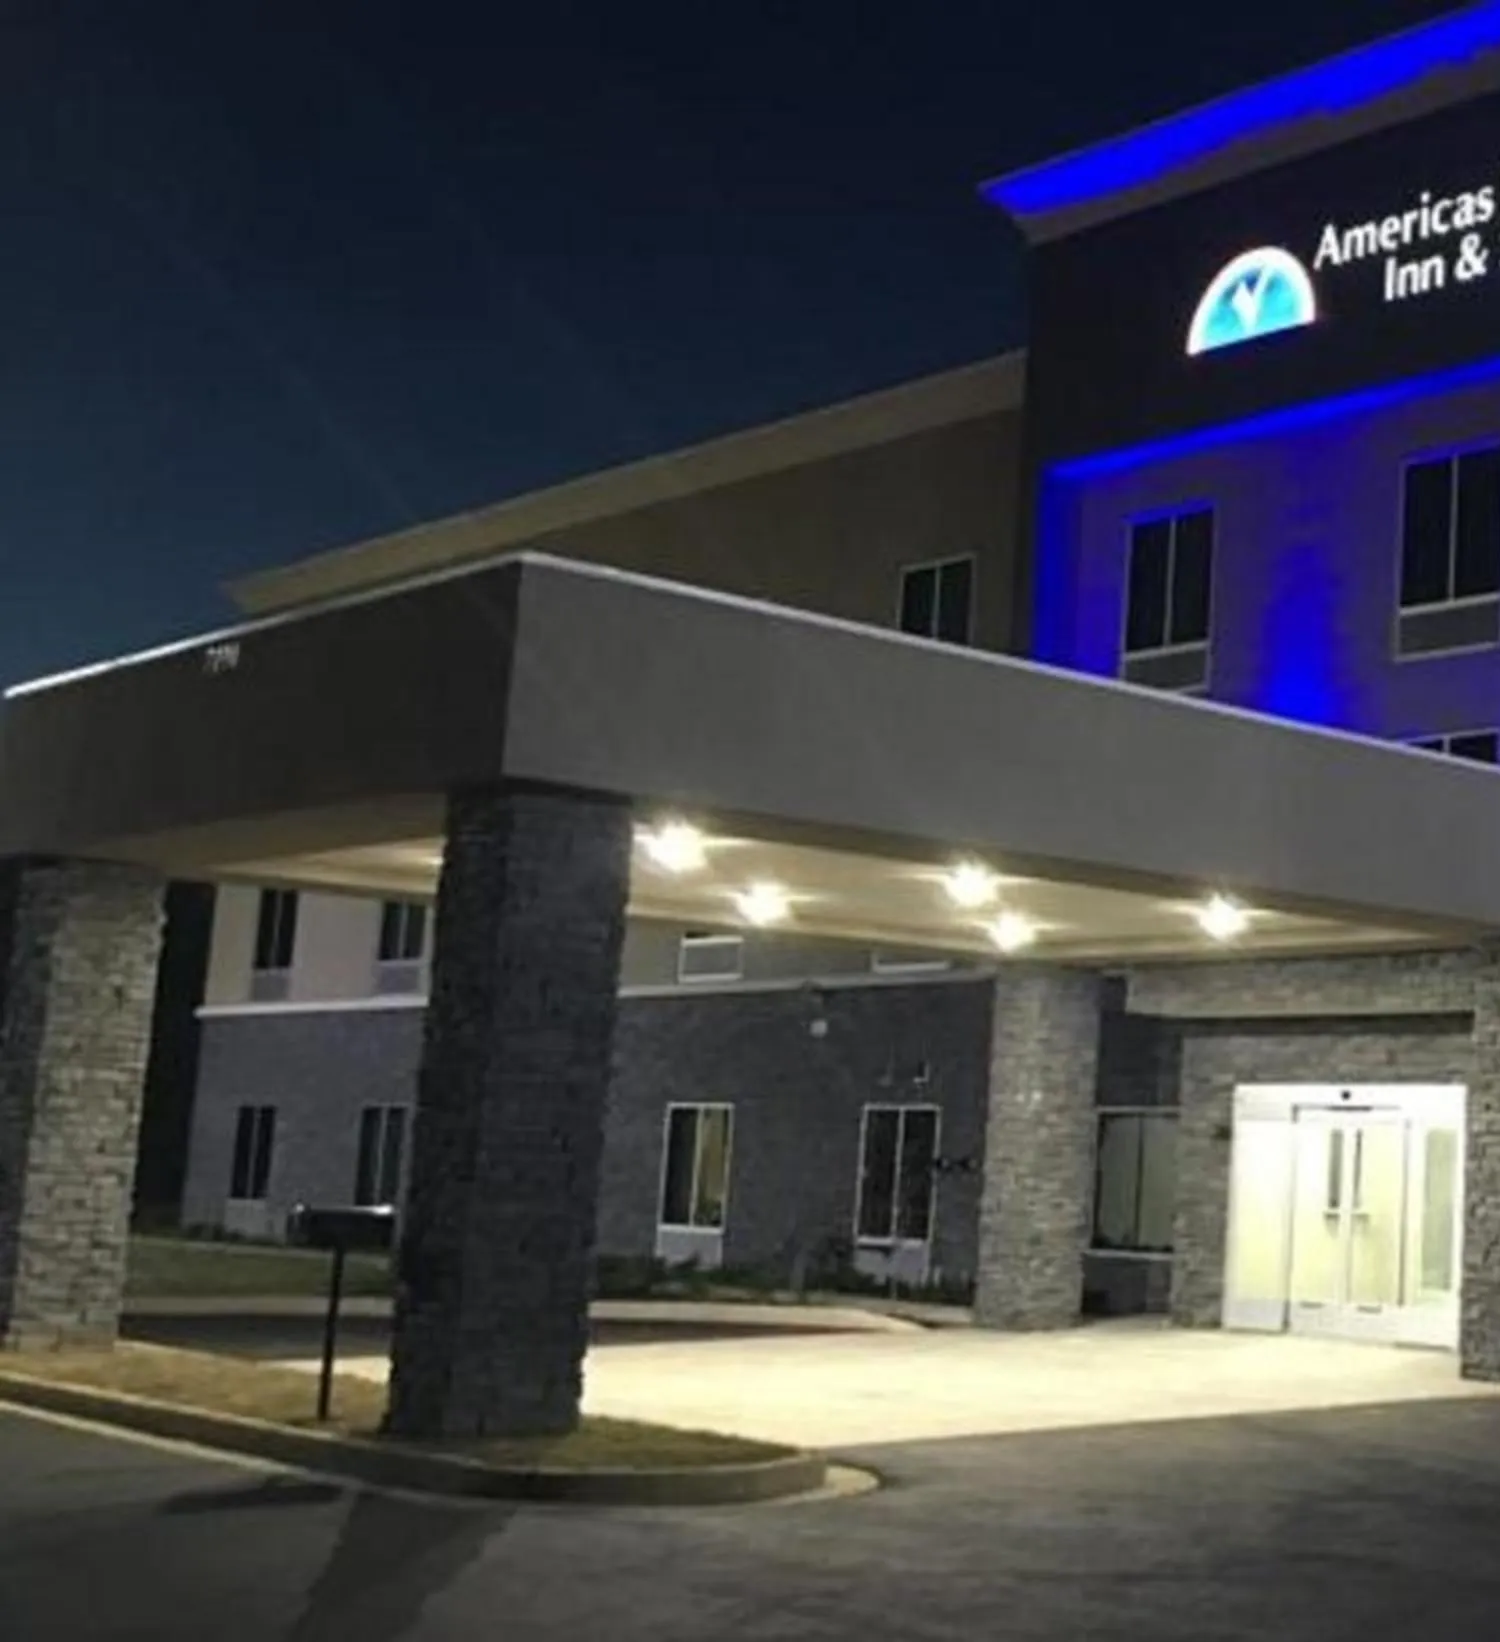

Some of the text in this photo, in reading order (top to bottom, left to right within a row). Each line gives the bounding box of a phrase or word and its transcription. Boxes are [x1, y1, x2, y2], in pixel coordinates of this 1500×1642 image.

[1313, 184, 1495, 270] Americas
[1383, 256, 1446, 301] Inn
[1453, 232, 1490, 282] &
